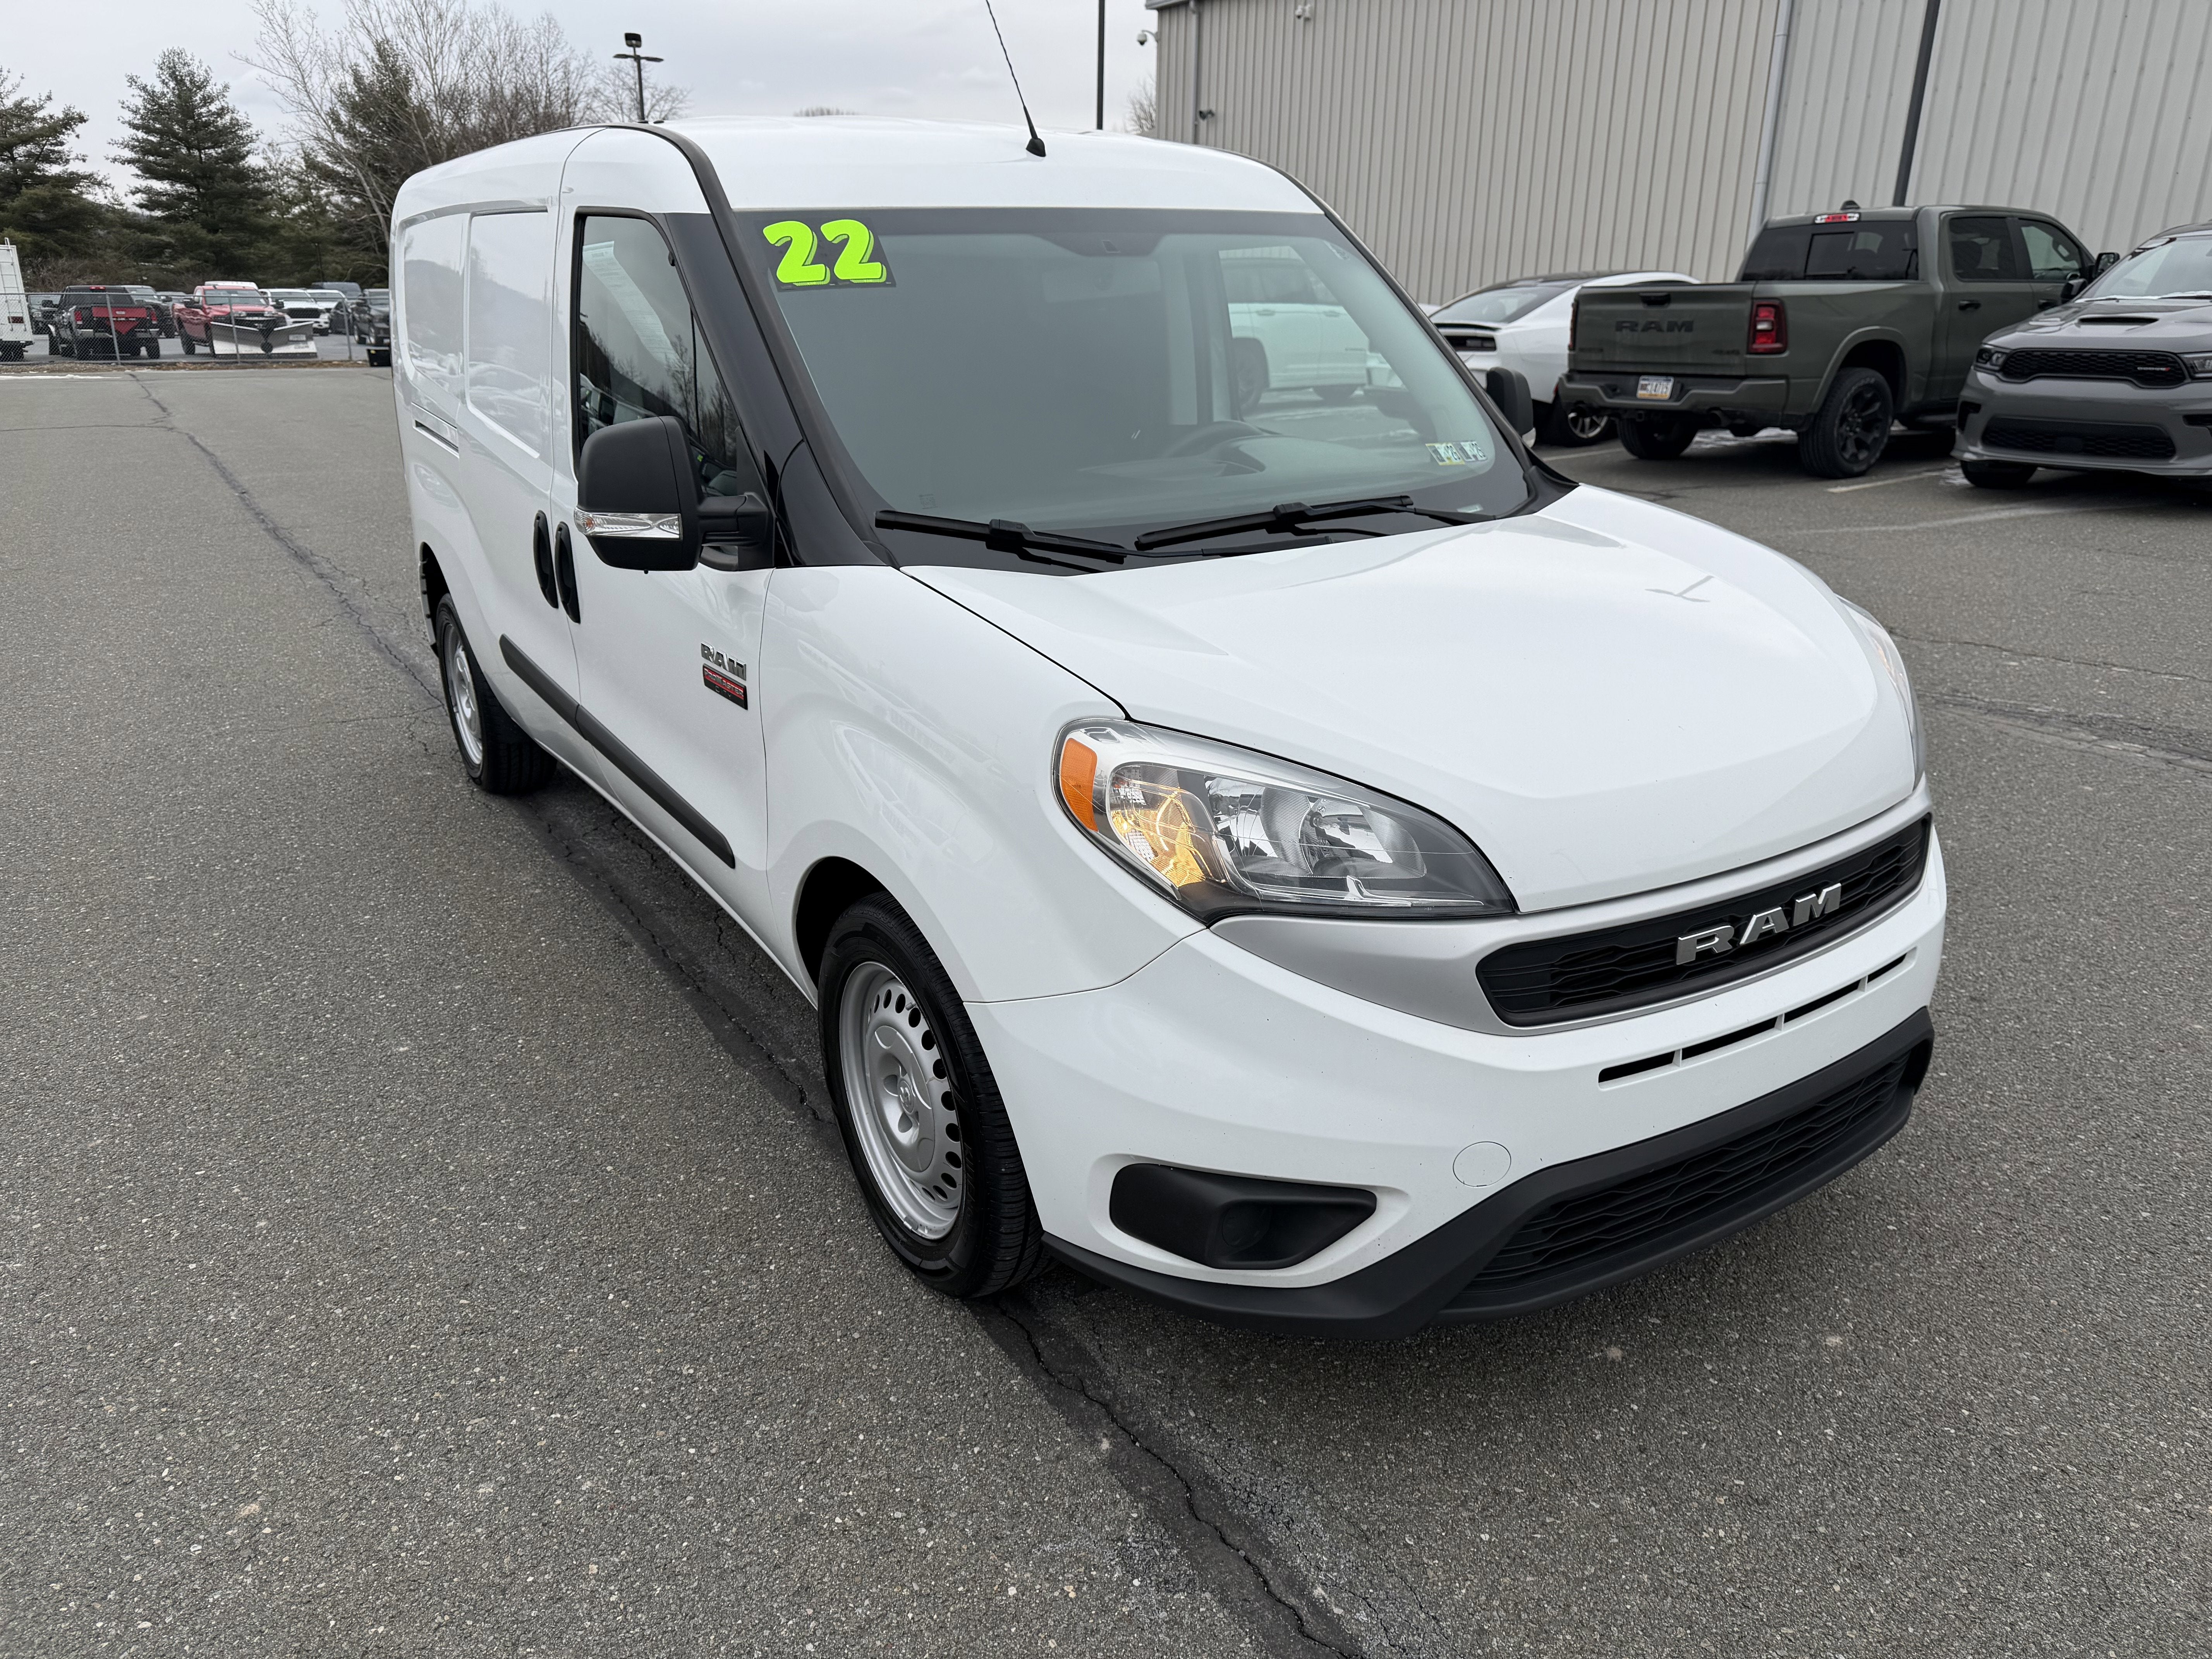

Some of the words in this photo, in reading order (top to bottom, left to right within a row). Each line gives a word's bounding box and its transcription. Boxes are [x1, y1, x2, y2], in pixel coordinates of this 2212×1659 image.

[763, 219, 887, 286] 22
[1615, 320, 1694, 332] RAM
[701, 642, 747, 681] RAM
[1676, 882, 1842, 966] RAM
